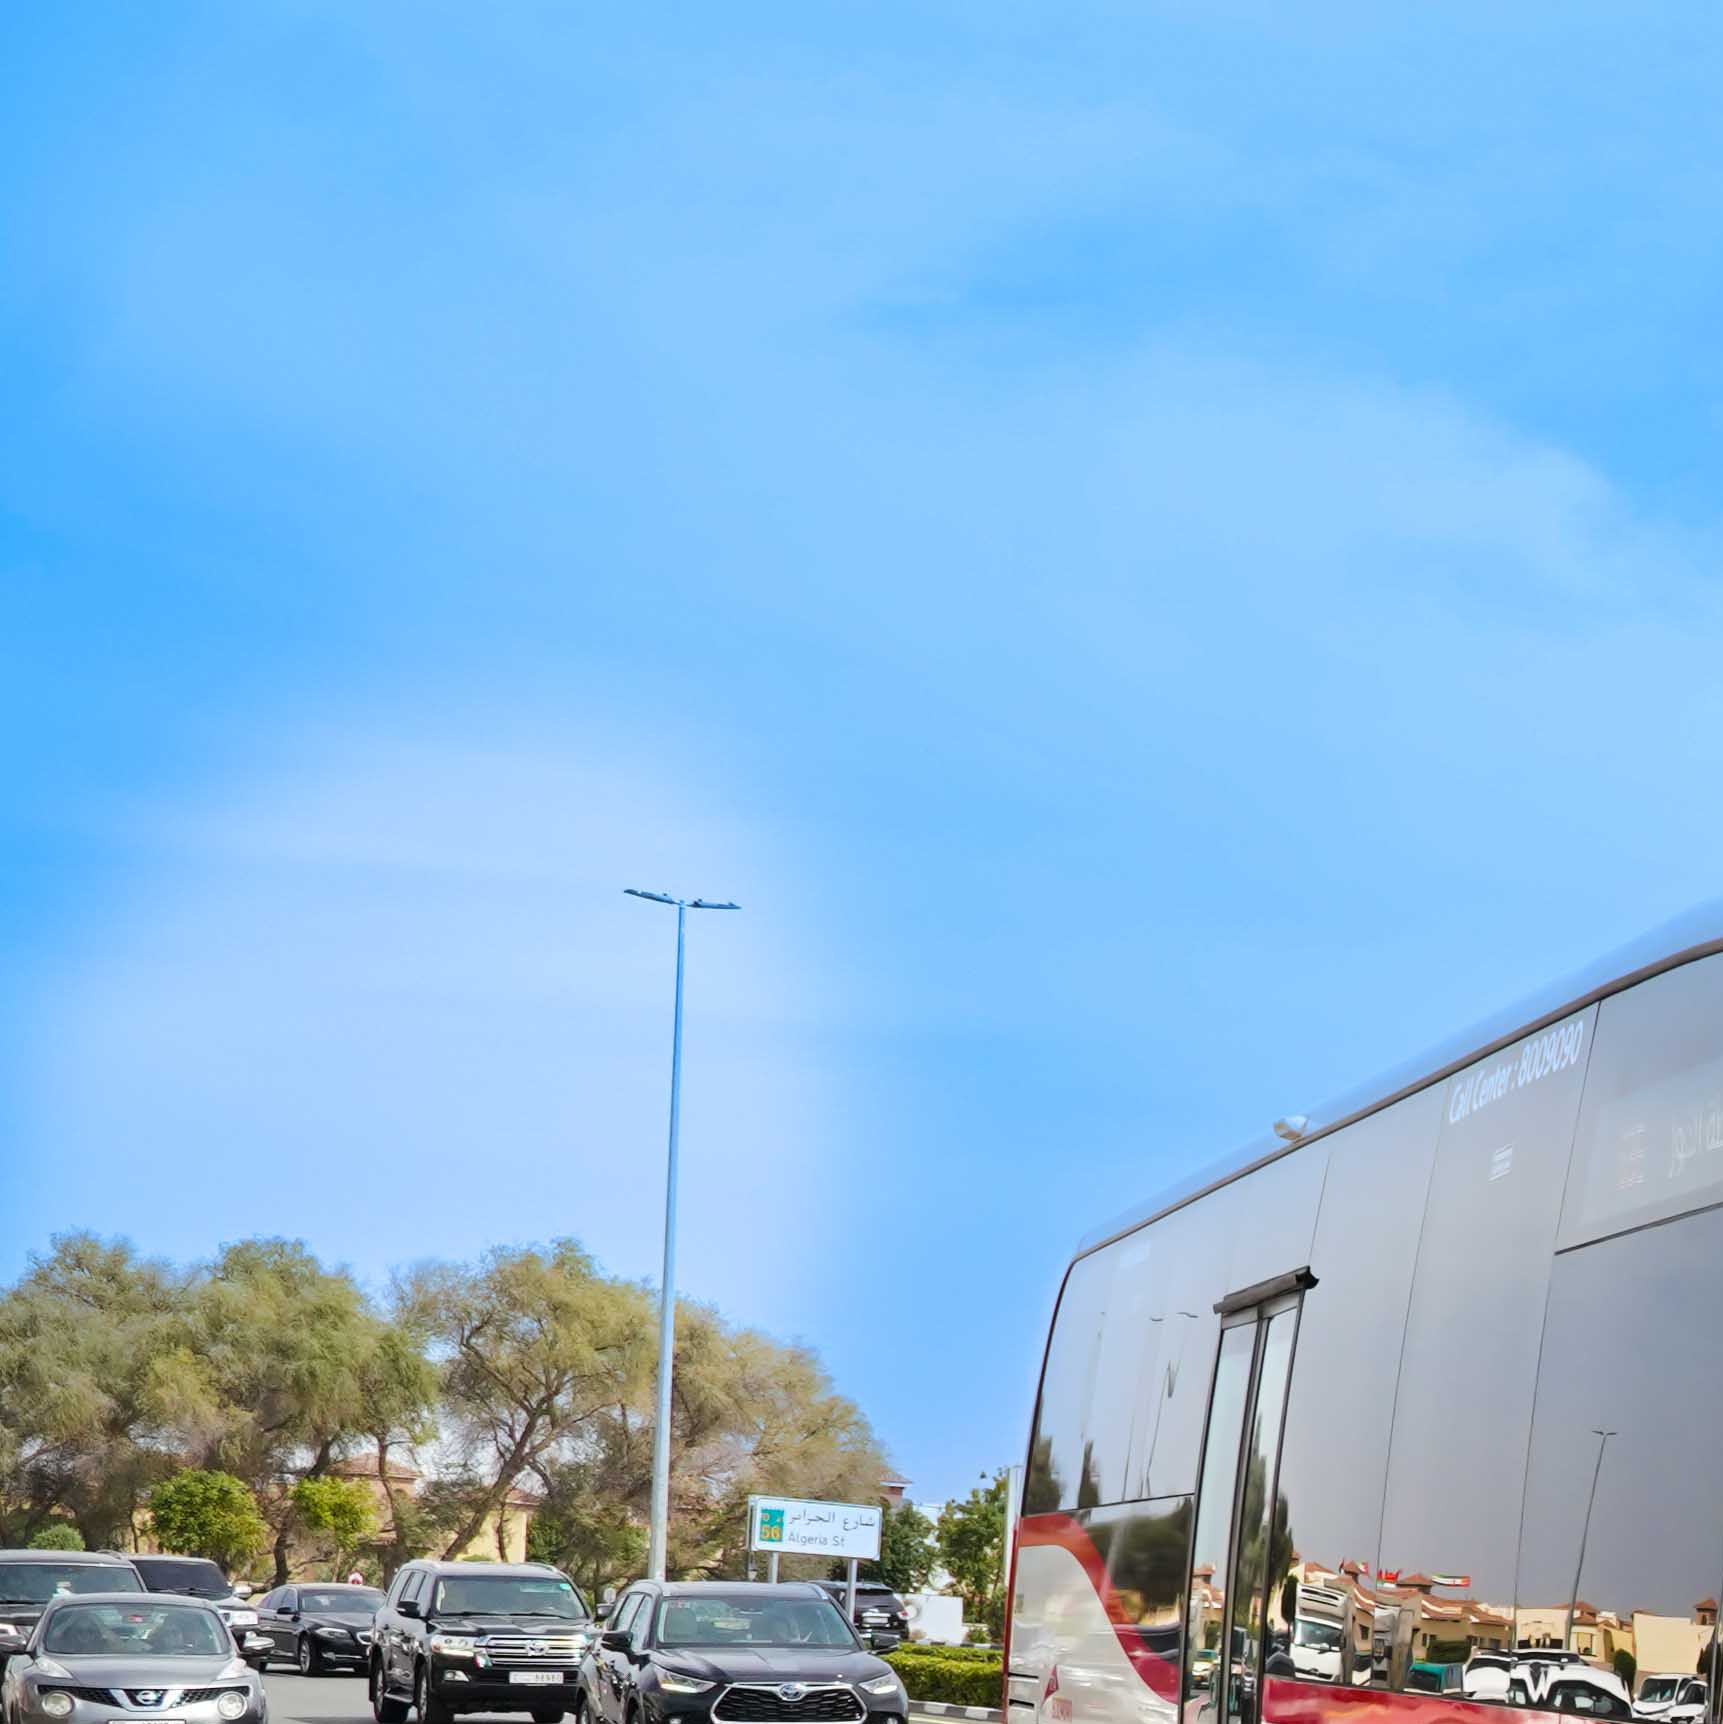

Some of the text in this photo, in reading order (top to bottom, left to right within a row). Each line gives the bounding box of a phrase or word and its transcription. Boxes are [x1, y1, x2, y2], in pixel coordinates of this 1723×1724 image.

[1449, 1074, 1474, 1124] Call
[1472, 1063, 1512, 1111] Center
[1518, 1020, 1584, 1087] 8009090
[788, 1533, 846, 1548] Algeria St
